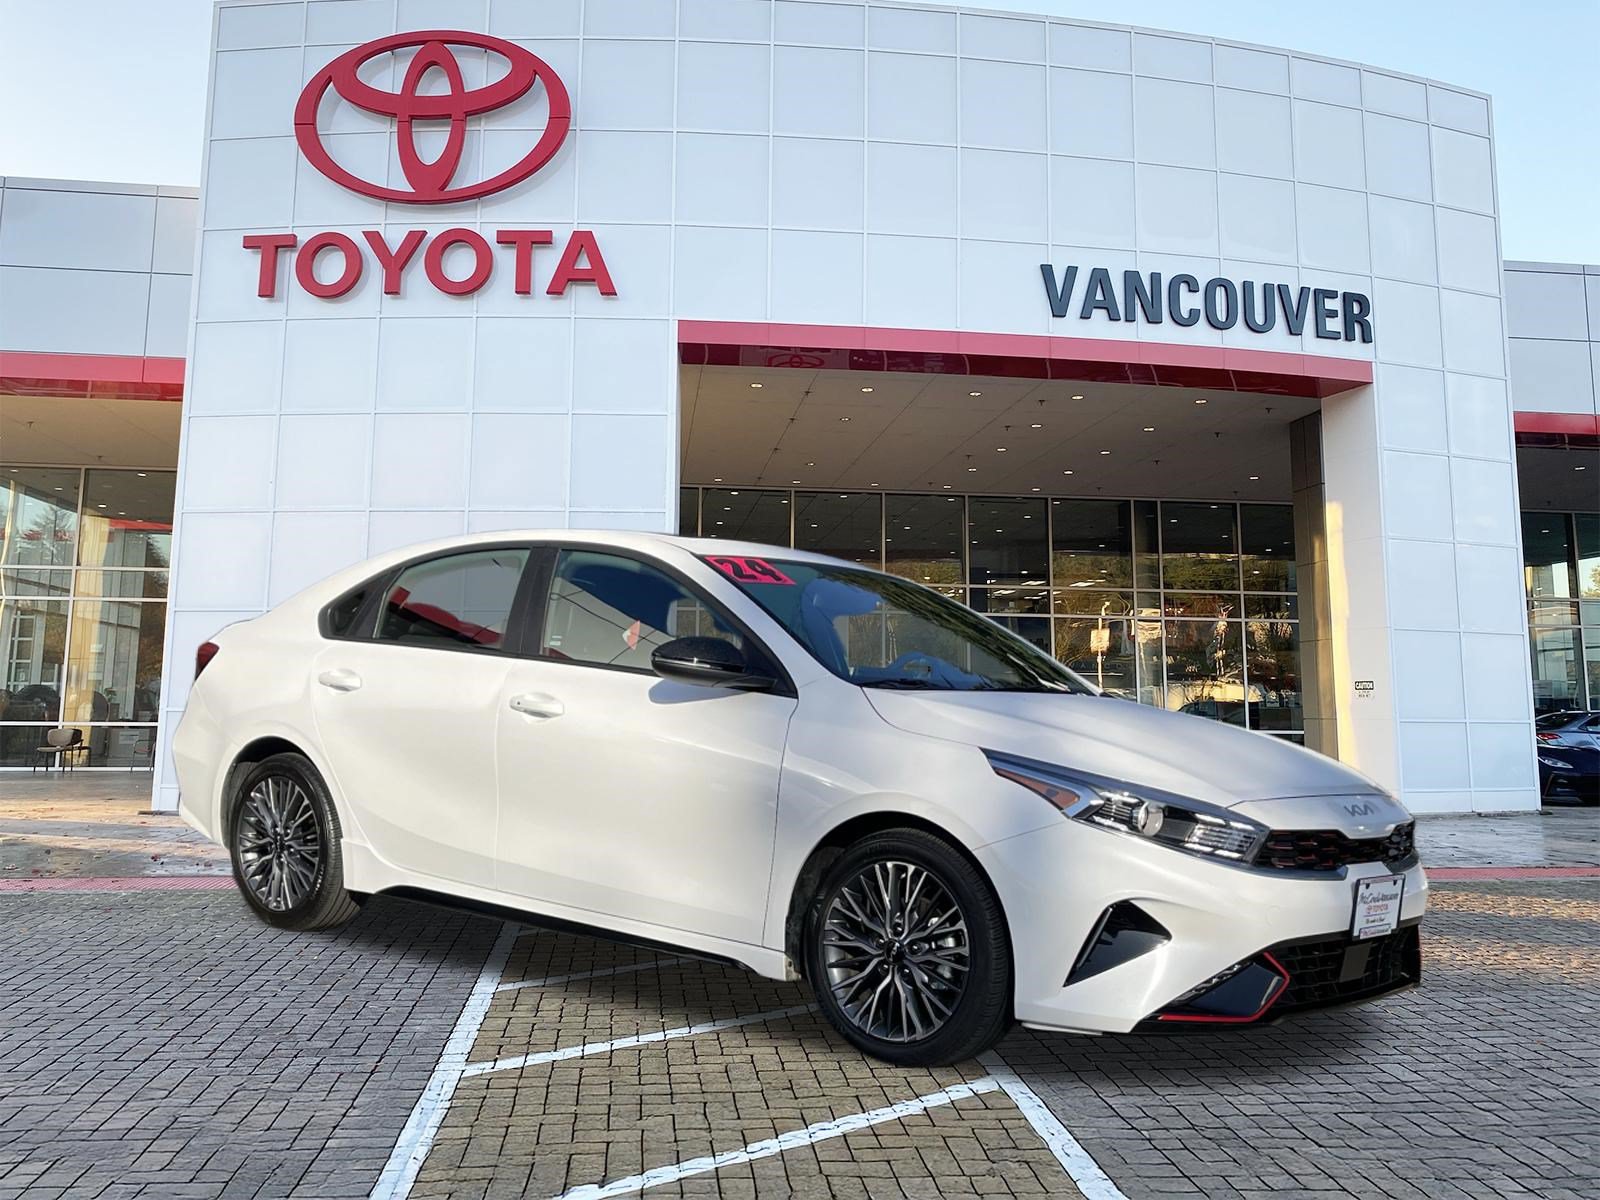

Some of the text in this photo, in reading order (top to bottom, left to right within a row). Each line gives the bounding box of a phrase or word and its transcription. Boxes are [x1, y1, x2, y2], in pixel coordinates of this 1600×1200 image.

[243, 228, 617, 298] TOYOTA
[1040, 264, 1373, 343] VANCOUVER
[1344, 804, 1374, 816] KIA
